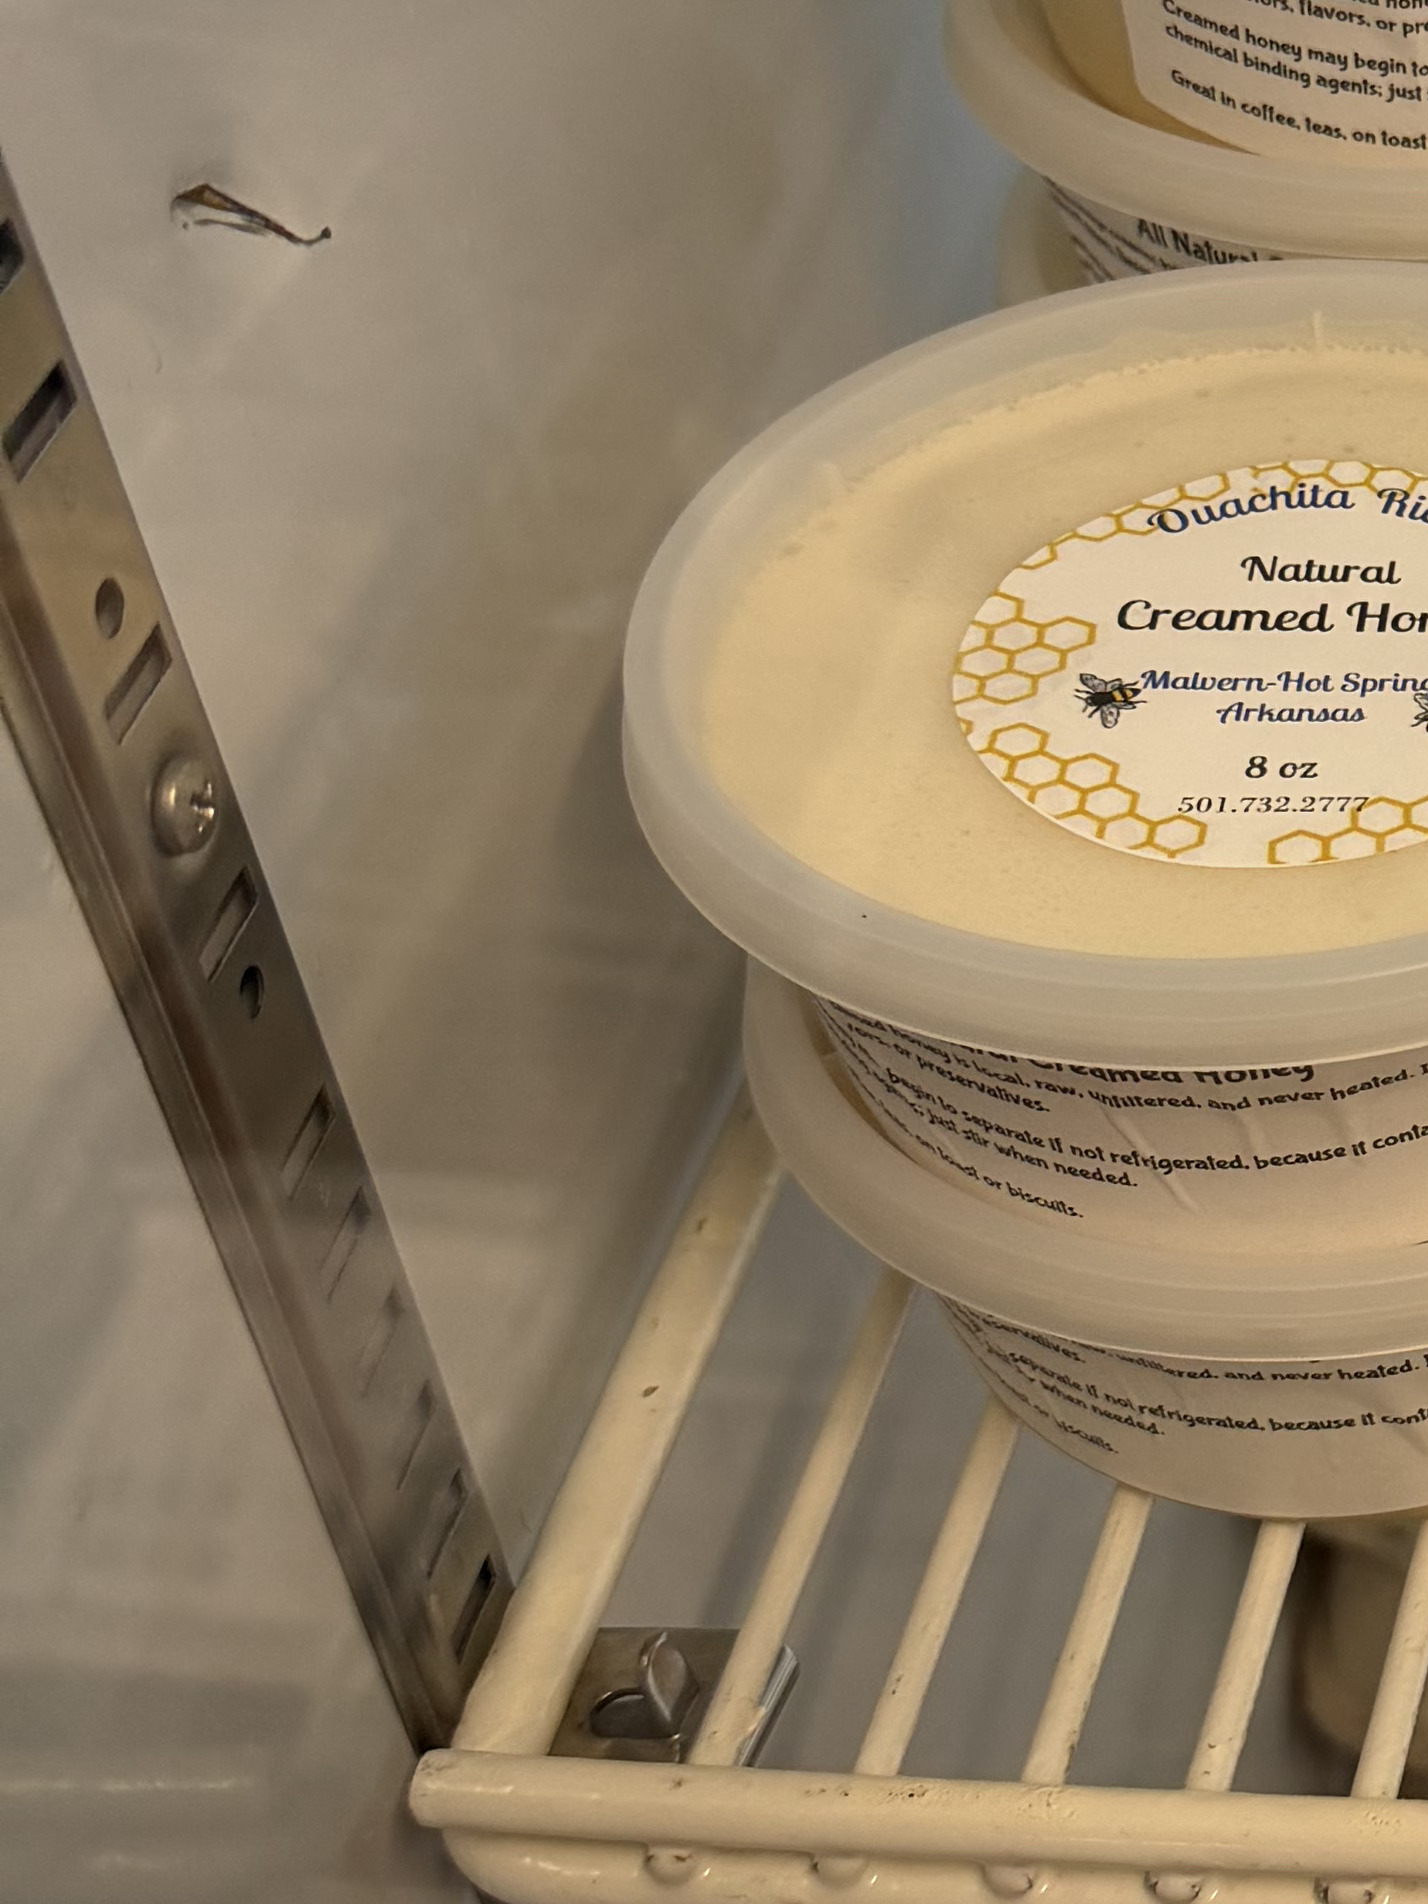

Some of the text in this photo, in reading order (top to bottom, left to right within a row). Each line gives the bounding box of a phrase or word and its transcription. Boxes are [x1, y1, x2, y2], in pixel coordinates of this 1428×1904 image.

[1374, 13, 1397, 32] or
[1171, 68, 1217, 102] Great
[1221, 90, 1237, 107] in
[1241, 101, 1300, 129] coffee,
[1305, 117, 1347, 140] teas,
[1352, 128, 1375, 142] on
[1380, 130, 1427, 149] toast
[1147, 482, 1355, 534] Ouachita
[1241, 555, 1401, 585] Natural
[1117, 599, 1333, 634] Creamed
[1140, 668, 1333, 694] Malvern-Hot
[1217, 702, 1367, 724] Arkansas
[1245, 756, 1319, 780] 8 oz
[1177, 797, 1369, 815] 501.732.2777
[1208, 1096, 1251, 1112] and
[1258, 1090, 1326, 1108] never
[1329, 1070, 1416, 1102] heated.
[1254, 1145, 1348, 1171] because
[1351, 1139, 1368, 1157] it
[1338, 1361, 1420, 1382] heated.
[1269, 1415, 1356, 1431] because
[1360, 1410, 1378, 1426] it
